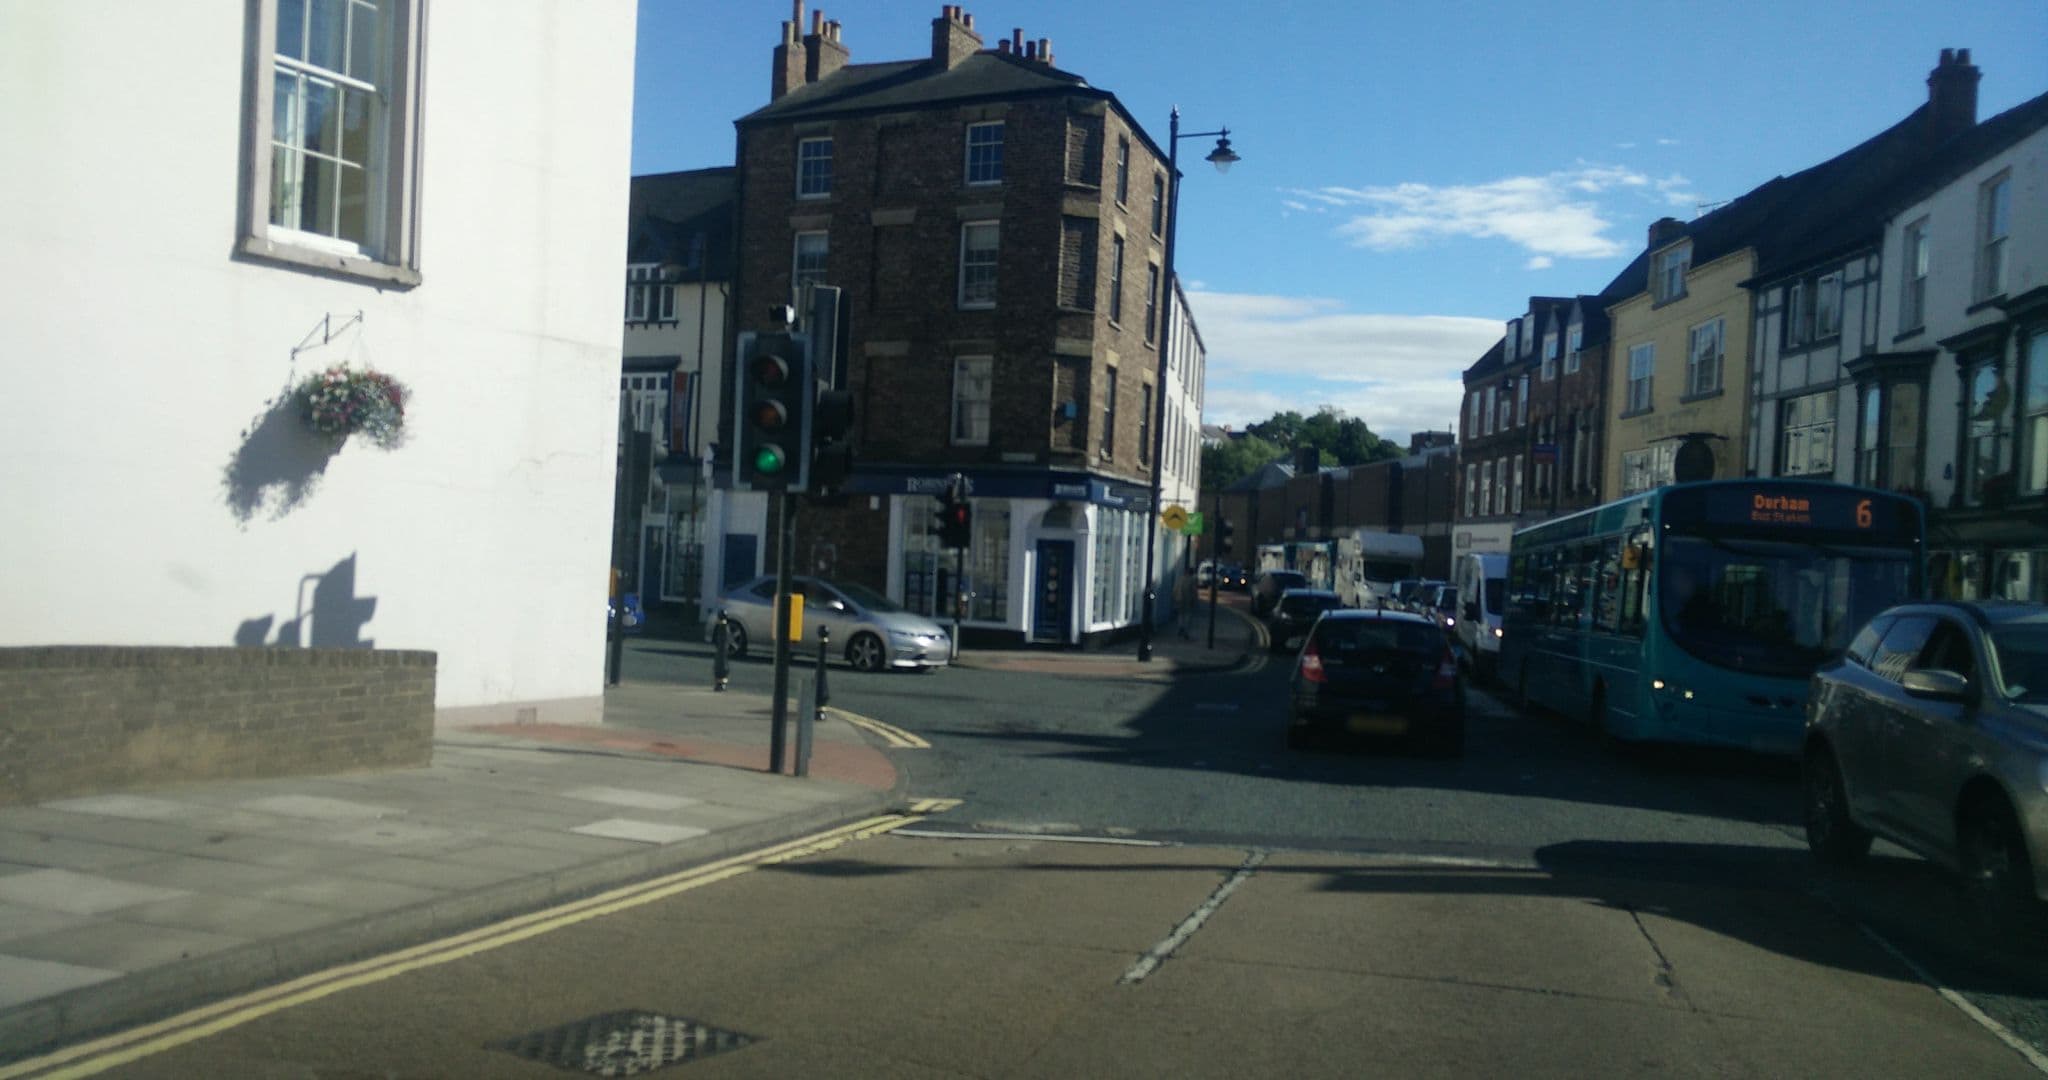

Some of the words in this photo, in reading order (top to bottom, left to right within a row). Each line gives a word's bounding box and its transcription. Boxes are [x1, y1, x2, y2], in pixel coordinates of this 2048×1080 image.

[907, 476, 974, 493] ROBINS
[1754, 495, 1810, 511] Durham
[1856, 500, 1872, 528] 6
